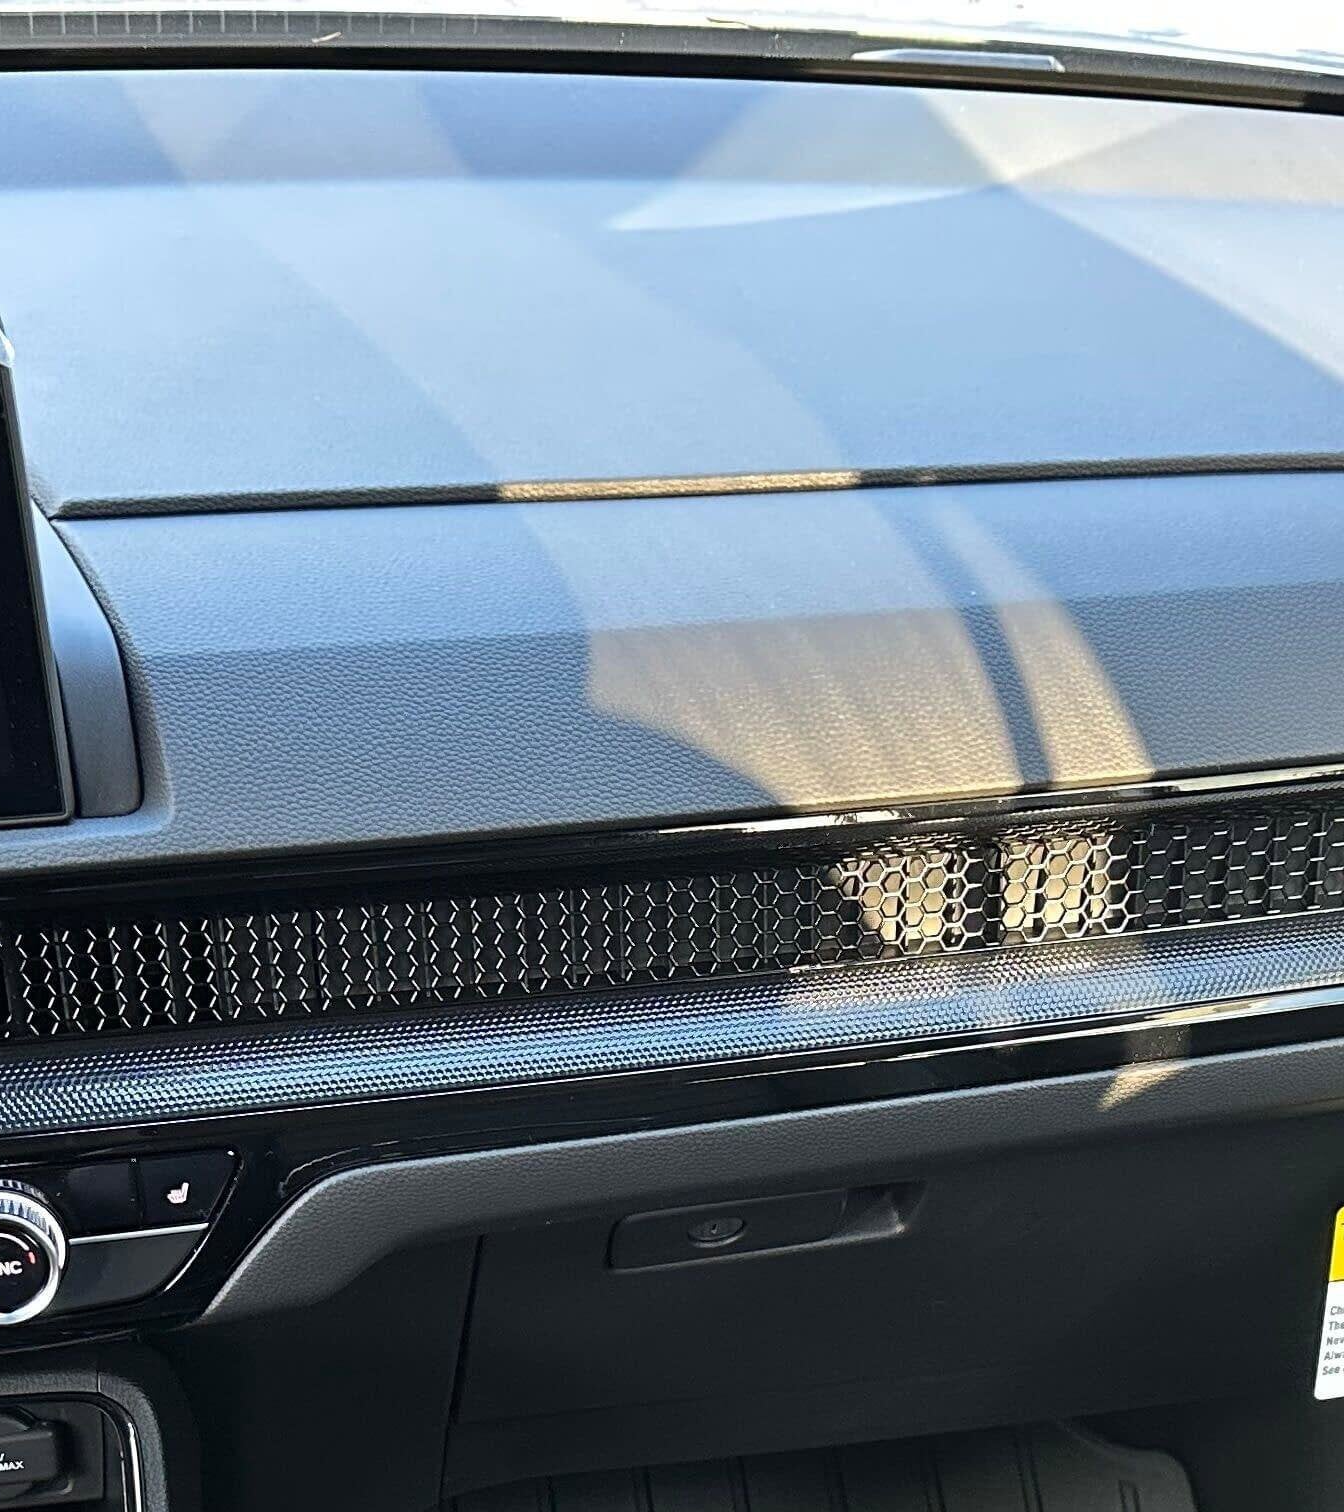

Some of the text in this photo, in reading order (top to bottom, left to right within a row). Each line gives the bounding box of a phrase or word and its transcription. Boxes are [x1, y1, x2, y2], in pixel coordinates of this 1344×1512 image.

[1329, 1320, 1344, 1330] The
[1322, 1365, 1340, 1376] See
[0, 1460, 25, 1472] MAX
